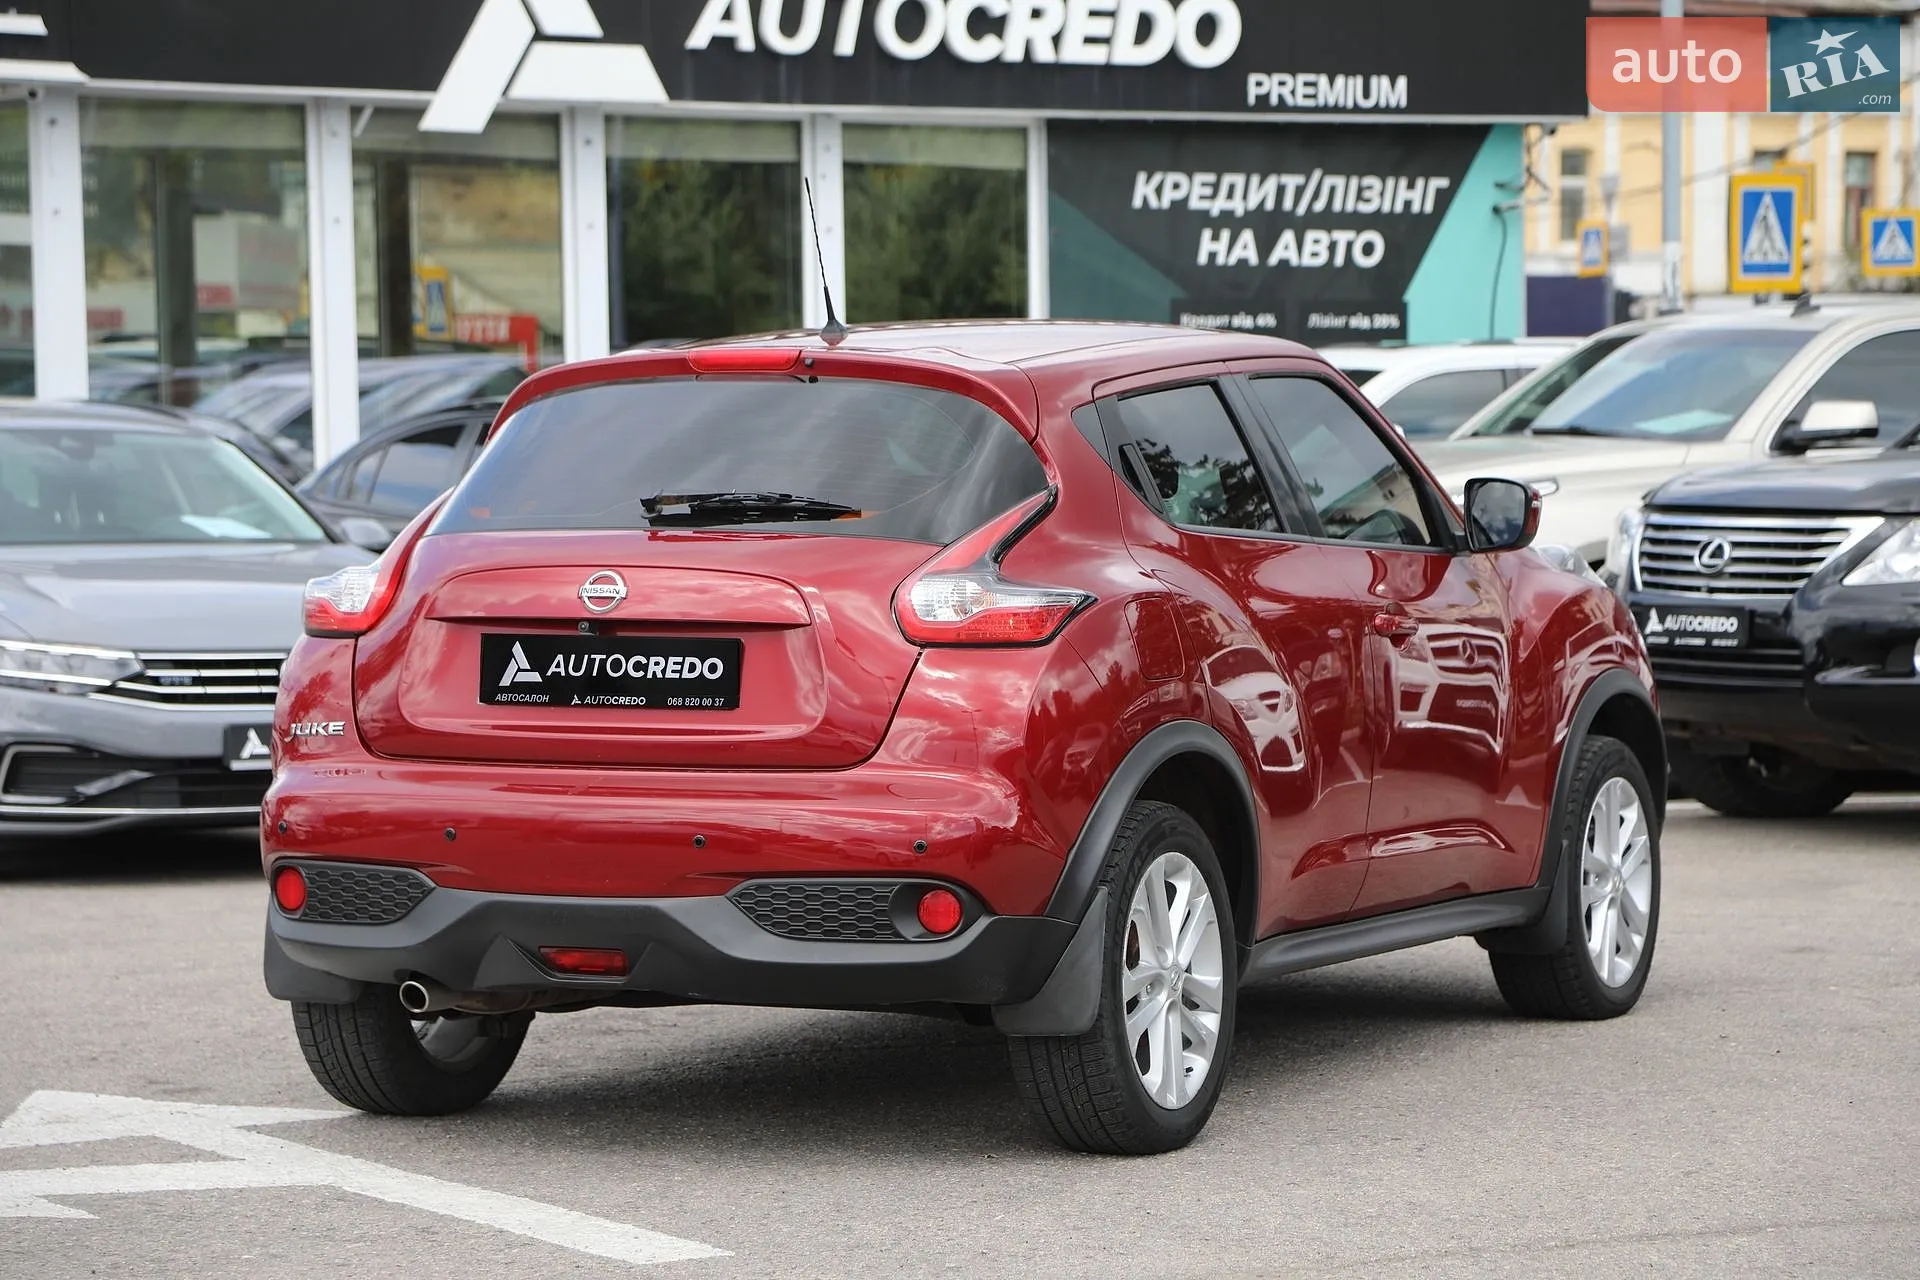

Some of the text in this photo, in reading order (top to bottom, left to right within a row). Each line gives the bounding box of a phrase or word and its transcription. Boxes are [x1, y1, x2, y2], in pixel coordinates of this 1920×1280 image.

[685, 0, 1243, 69] AUTOCREDO
[1247, 72, 1408, 109] PREMIUM
[1131, 168, 1451, 217] КРЕДИТ/ЛІЗІНГ
[1197, 227, 1386, 269] НА АВТО
[580, 587, 620, 595] NISSAN
[546, 653, 724, 680] AUTOCREDO
[495, 693, 550, 703] АВТОСАЛОН
[584, 695, 647, 706] AUTOCREDO
[667, 697, 724, 707] 068 820 00 37
[283, 721, 346, 743] JUKE
